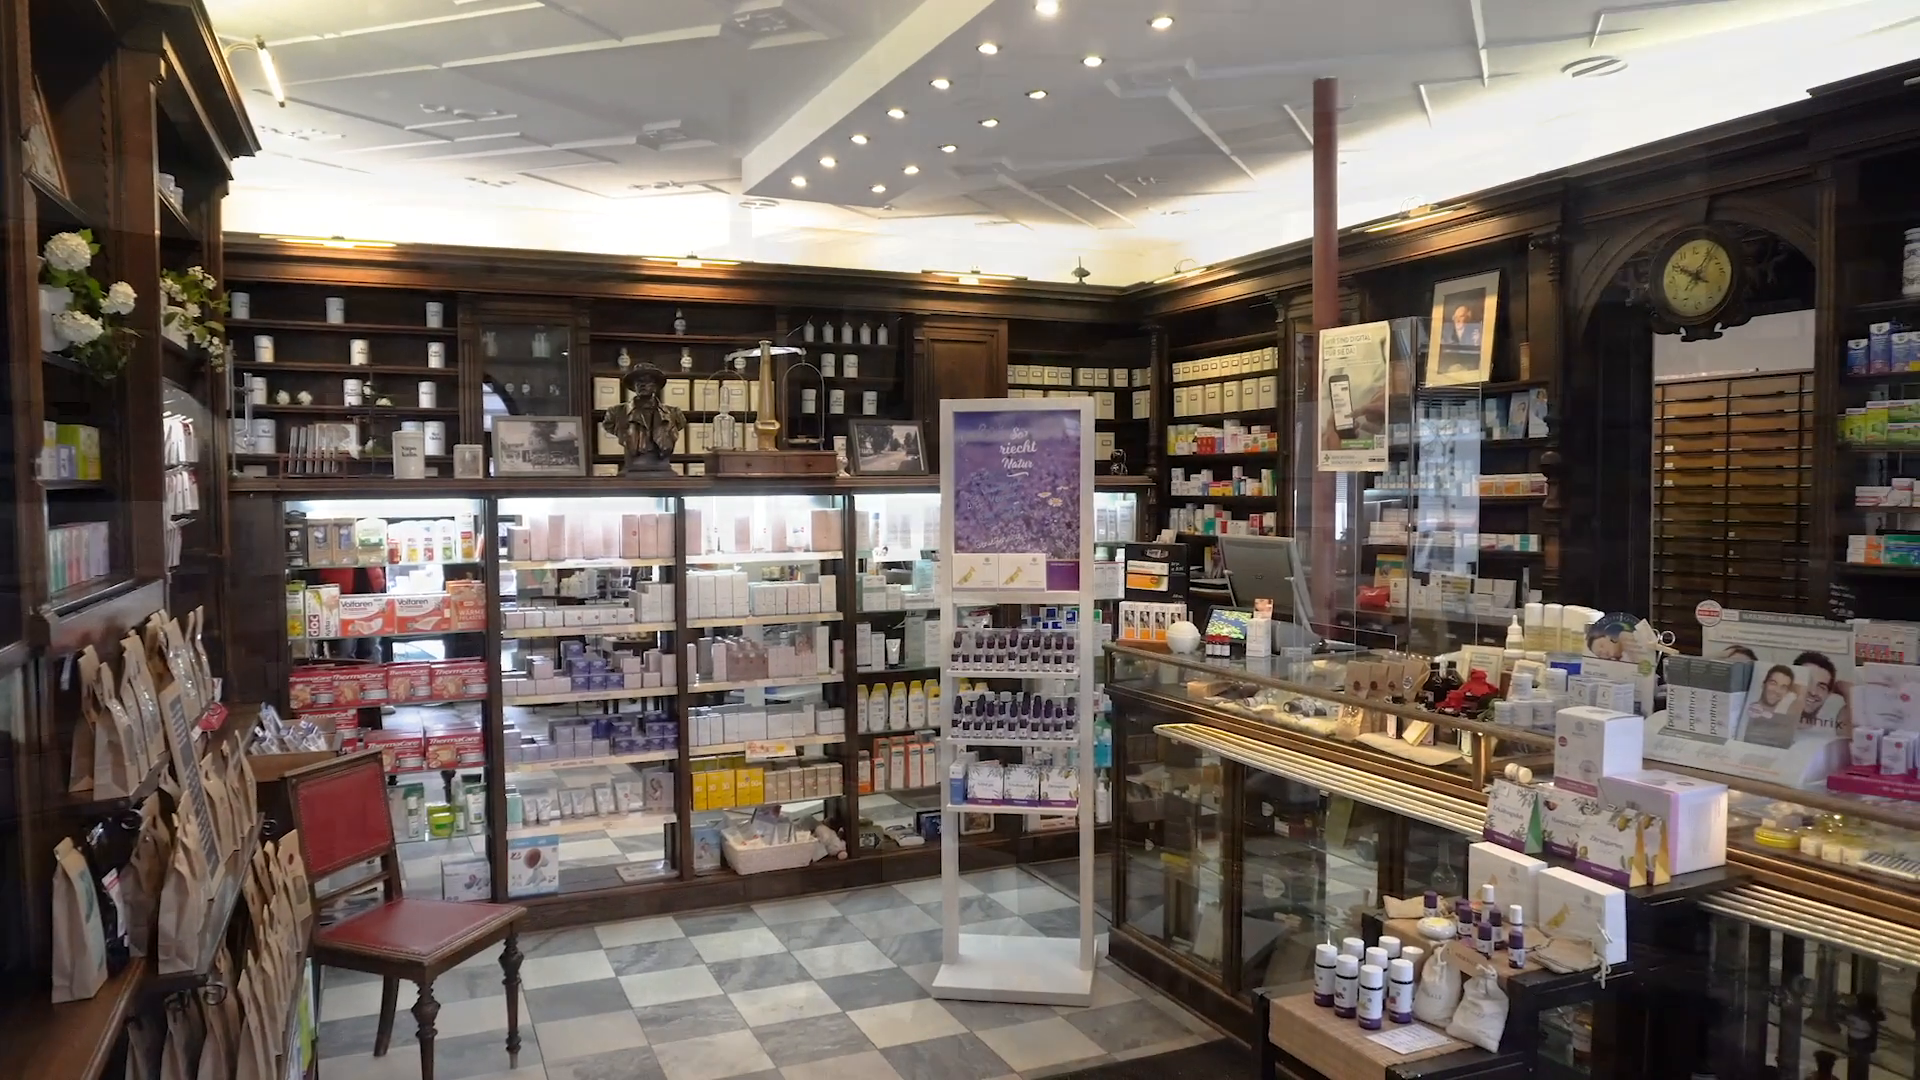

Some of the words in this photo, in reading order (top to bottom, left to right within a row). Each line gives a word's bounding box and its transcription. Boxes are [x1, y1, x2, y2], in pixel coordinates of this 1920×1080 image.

[1336, 336, 1350, 344] SIND
[1349, 334, 1371, 343] DIGITAL
[1010, 426, 1028, 440] So
[999, 439, 1038, 454] riecht
[1001, 457, 1034, 469] Natur
[340, 600, 373, 608] Voltaren
[397, 598, 428, 606] Voltaren
[308, 614, 320, 637] doc
[333, 672, 385, 680] ThermaCare
[435, 667, 485, 676] ThermaCare
[1667, 687, 1675, 728] panthrix
[1688, 690, 1697, 732] panthrix
[1709, 693, 1719, 735] panthrix
[367, 740, 420, 749] ThermaCare
[428, 736, 480, 744] ThermaCare
